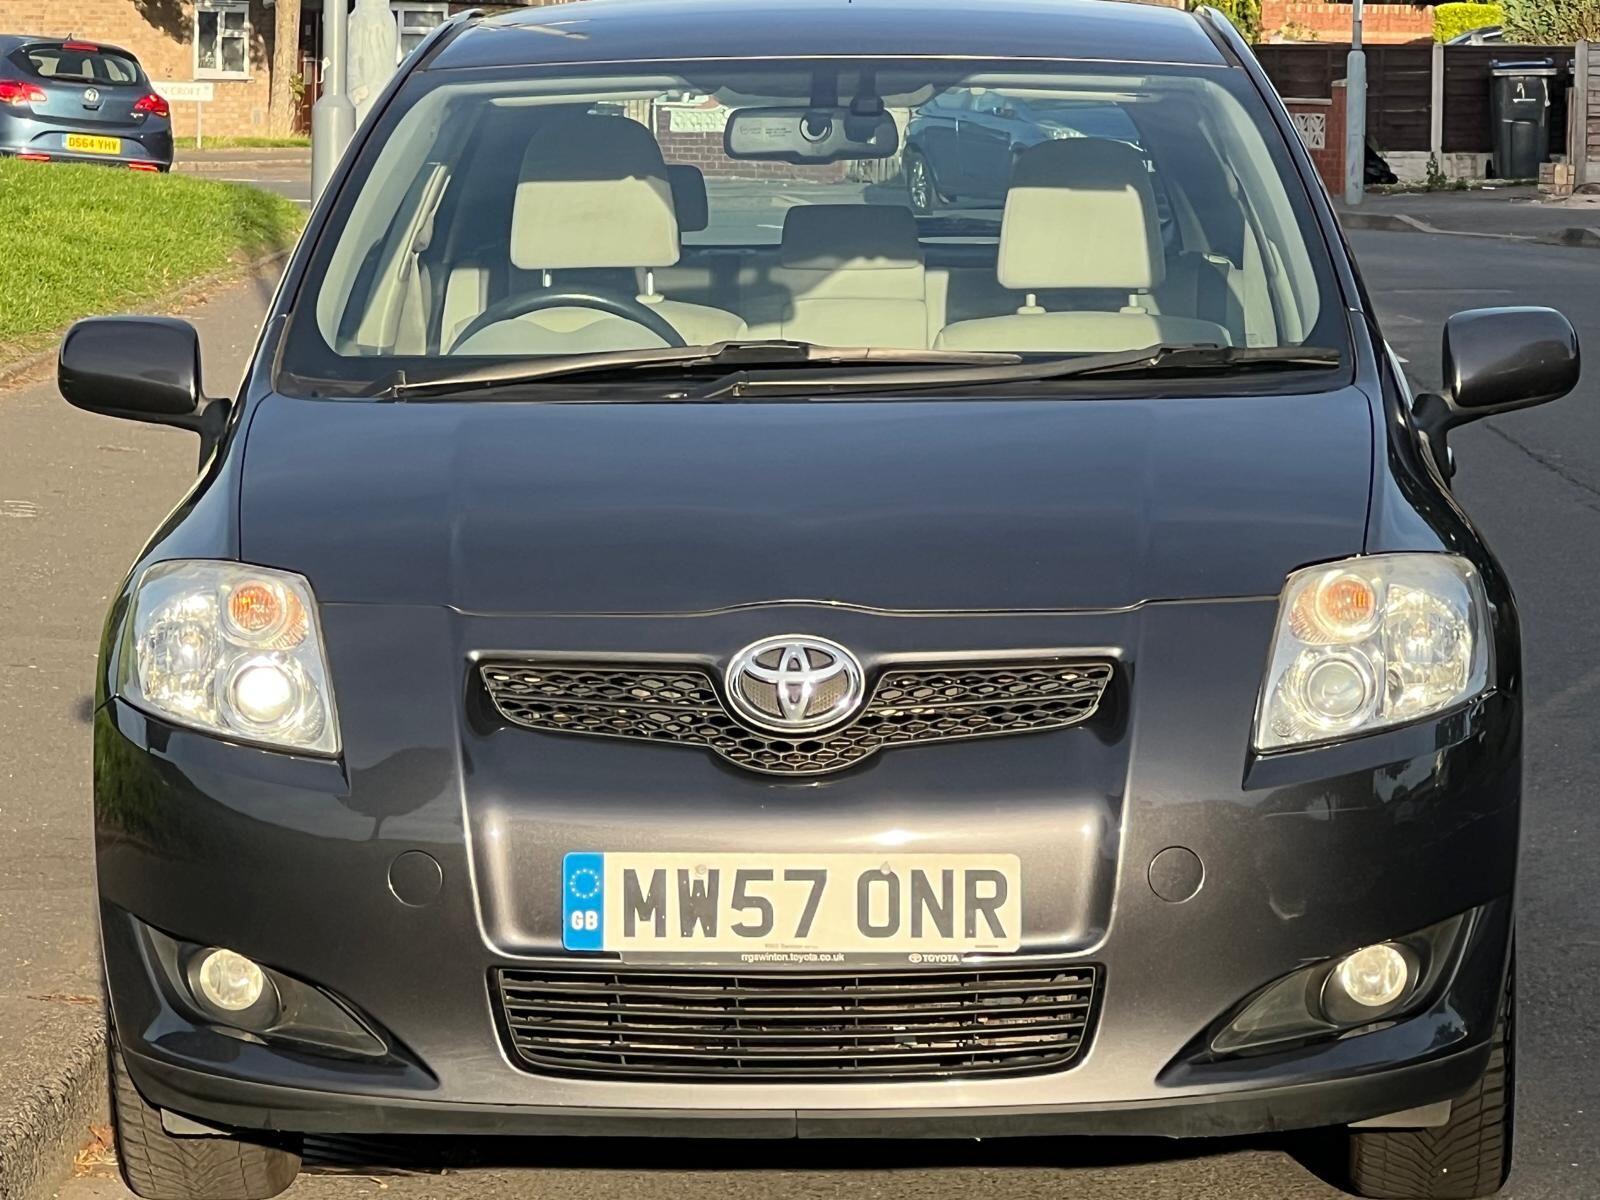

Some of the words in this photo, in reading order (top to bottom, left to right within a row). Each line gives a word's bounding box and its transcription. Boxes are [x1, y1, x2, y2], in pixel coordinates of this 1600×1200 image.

[170, 86, 201, 96] CROFT
[69, 137, 94, 148] DS64
[98, 139, 118, 151] YHV
[623, 869, 828, 938] MW57
[857, 869, 1008, 939] ONR
[571, 910, 598, 931] GB
[741, 952, 845, 963] rrgswinton.toyota.co.uk
[922, 953, 960, 963] TOYOTA
